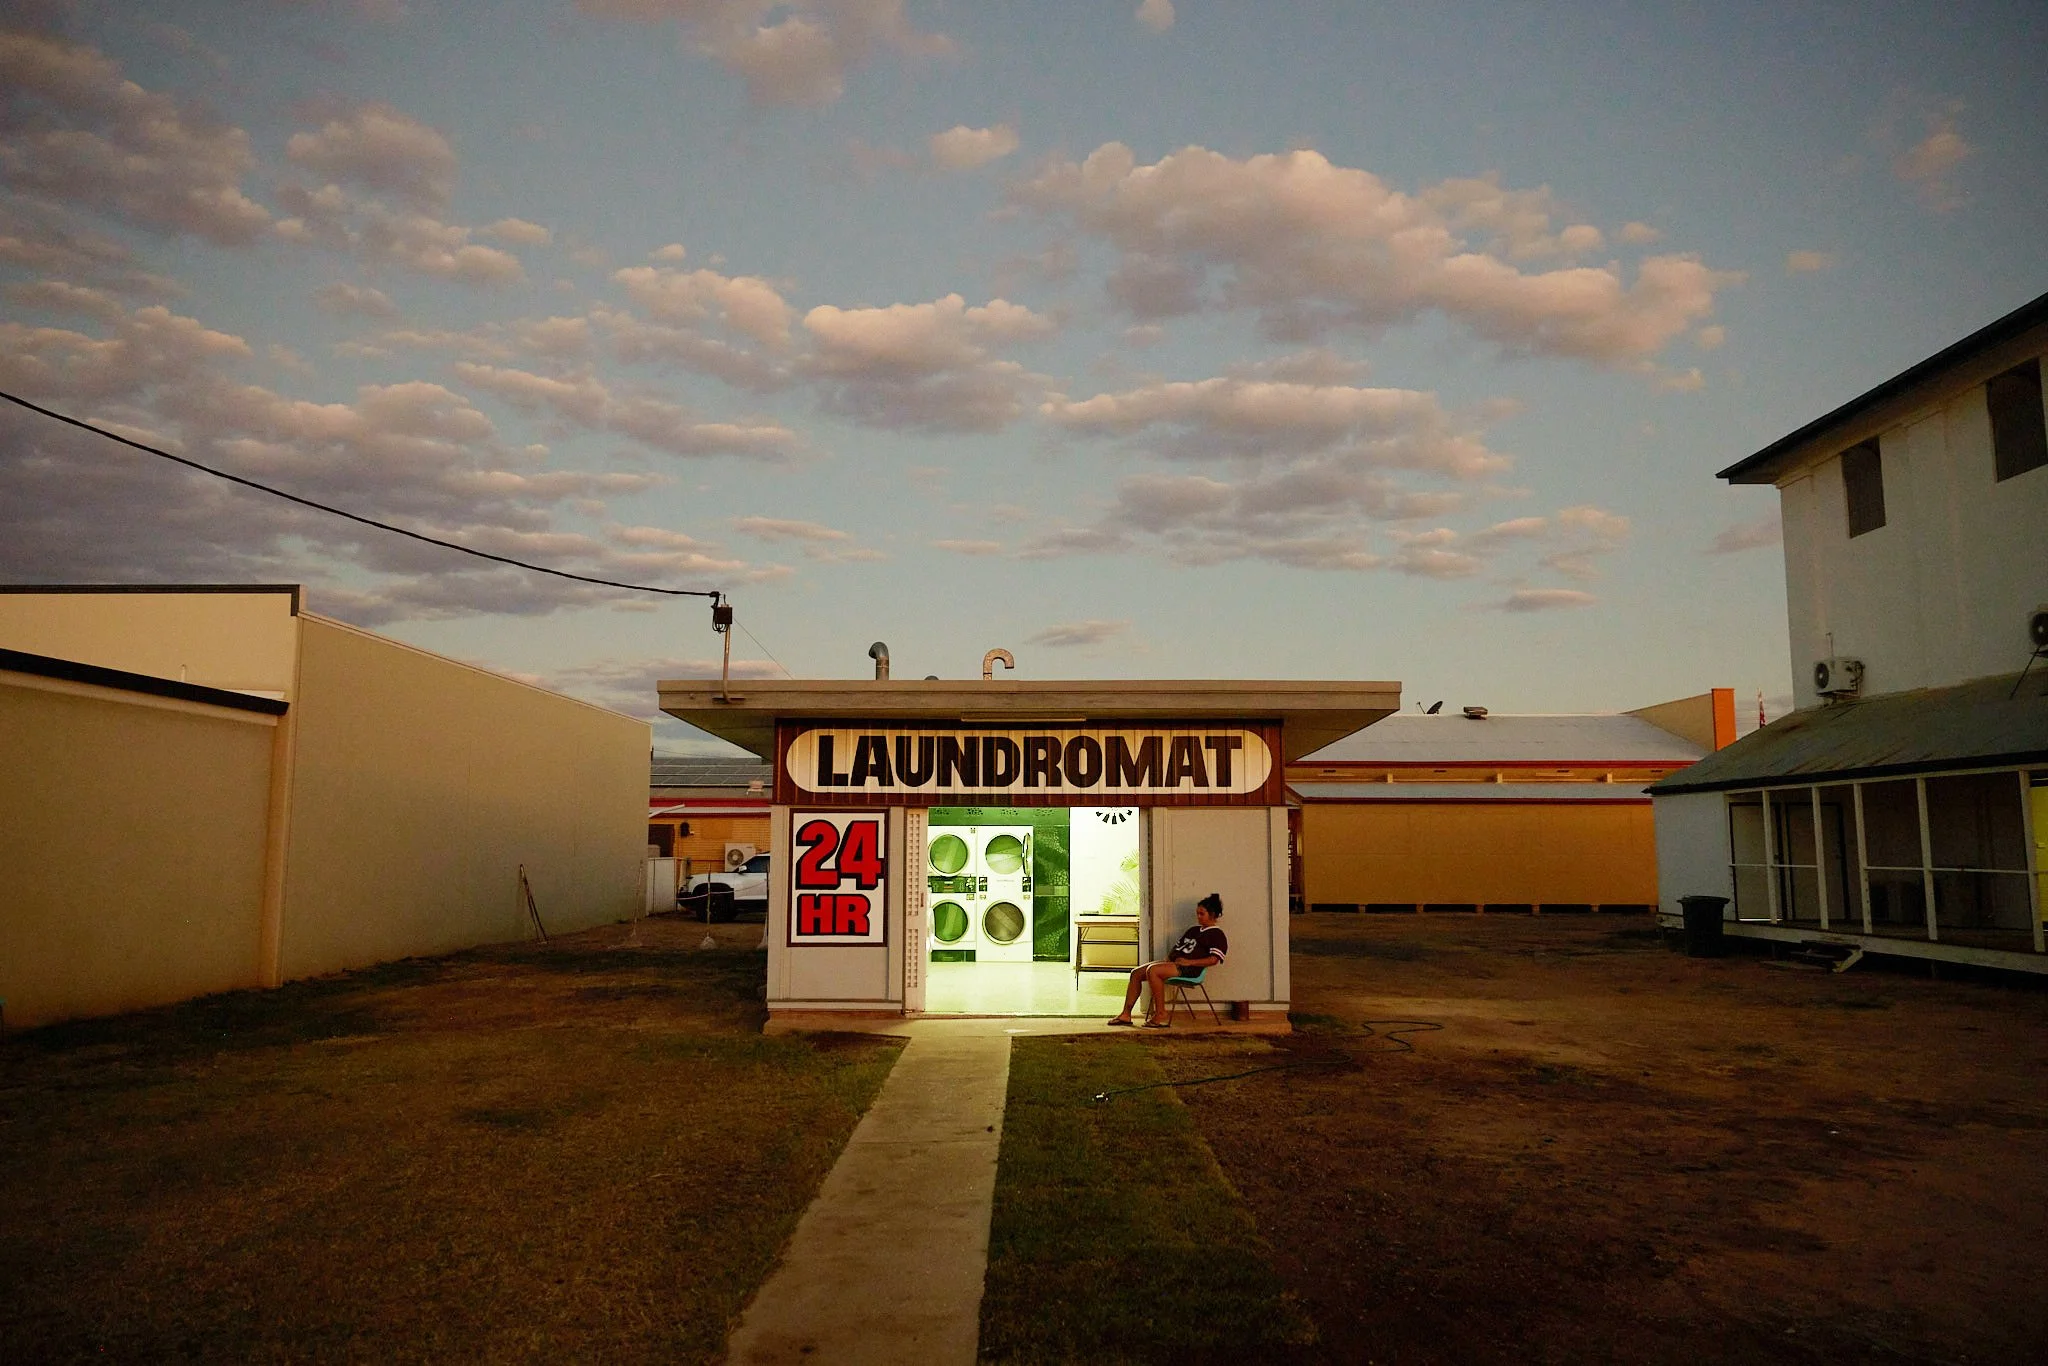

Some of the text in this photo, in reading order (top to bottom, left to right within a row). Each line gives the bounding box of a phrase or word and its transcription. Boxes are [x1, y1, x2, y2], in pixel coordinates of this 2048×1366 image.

[819, 735, 1242, 787] LAUNDROMAT
[795, 819, 884, 890] 24
[796, 893, 871, 936] HR
